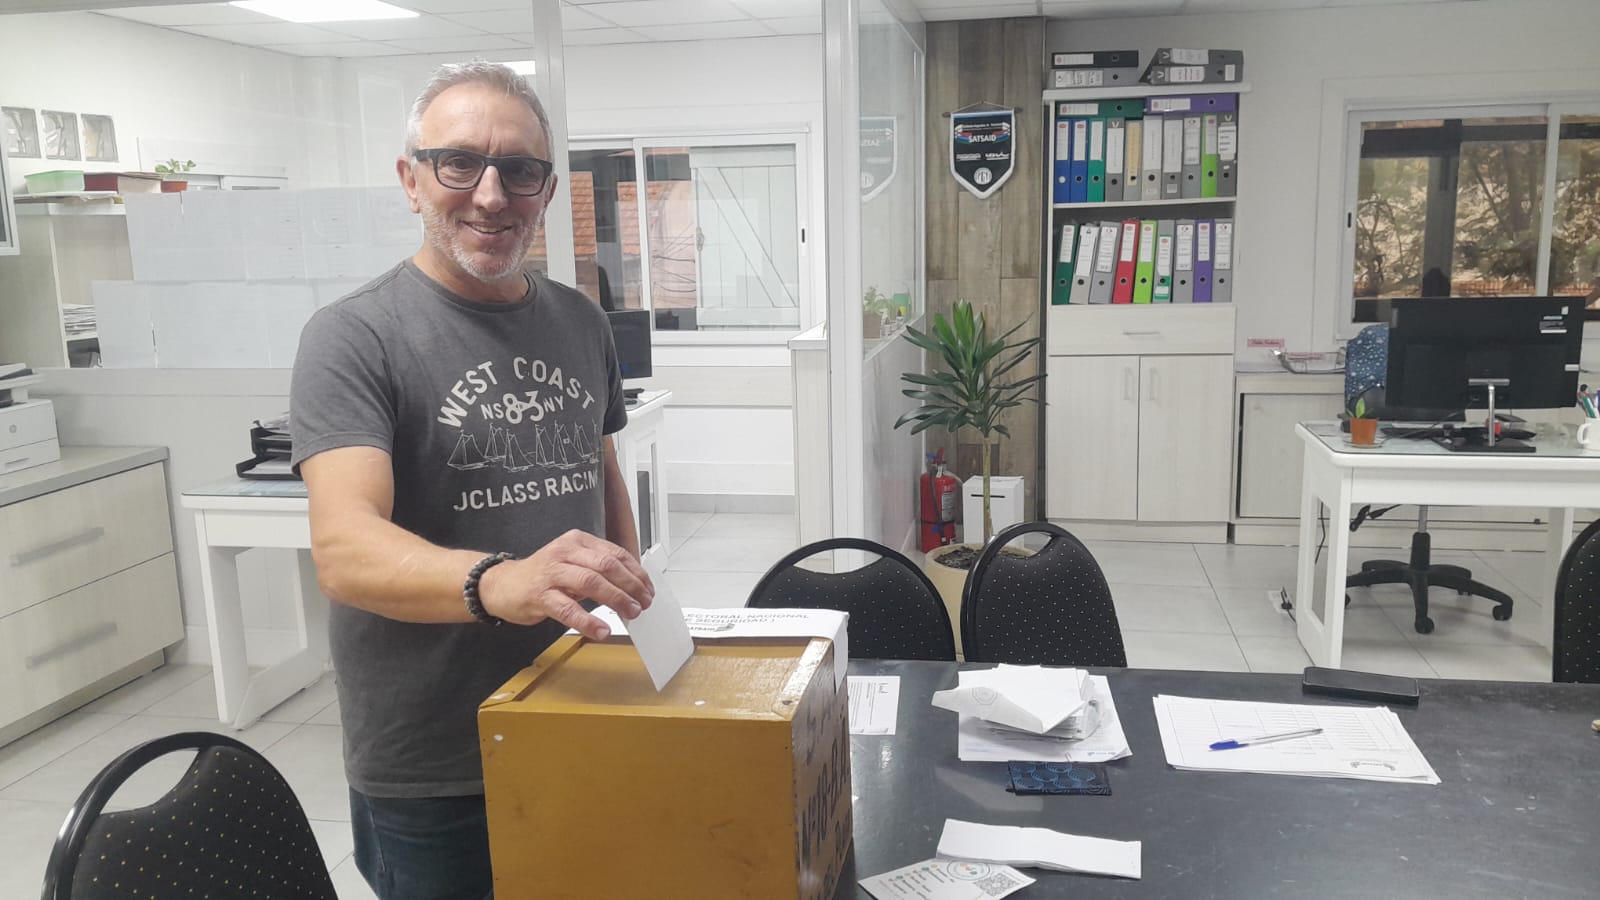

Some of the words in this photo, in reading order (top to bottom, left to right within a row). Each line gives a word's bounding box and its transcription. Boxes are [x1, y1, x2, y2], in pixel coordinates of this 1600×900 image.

[968, 134, 997, 143] SATSAID
[437, 361, 498, 428] WEST
[513, 356, 595, 409] COAST
[480, 403, 504, 420] NS
[543, 395, 564, 412] NY
[453, 481, 541, 511] JCLASS
[544, 469, 599, 497] RACIN
